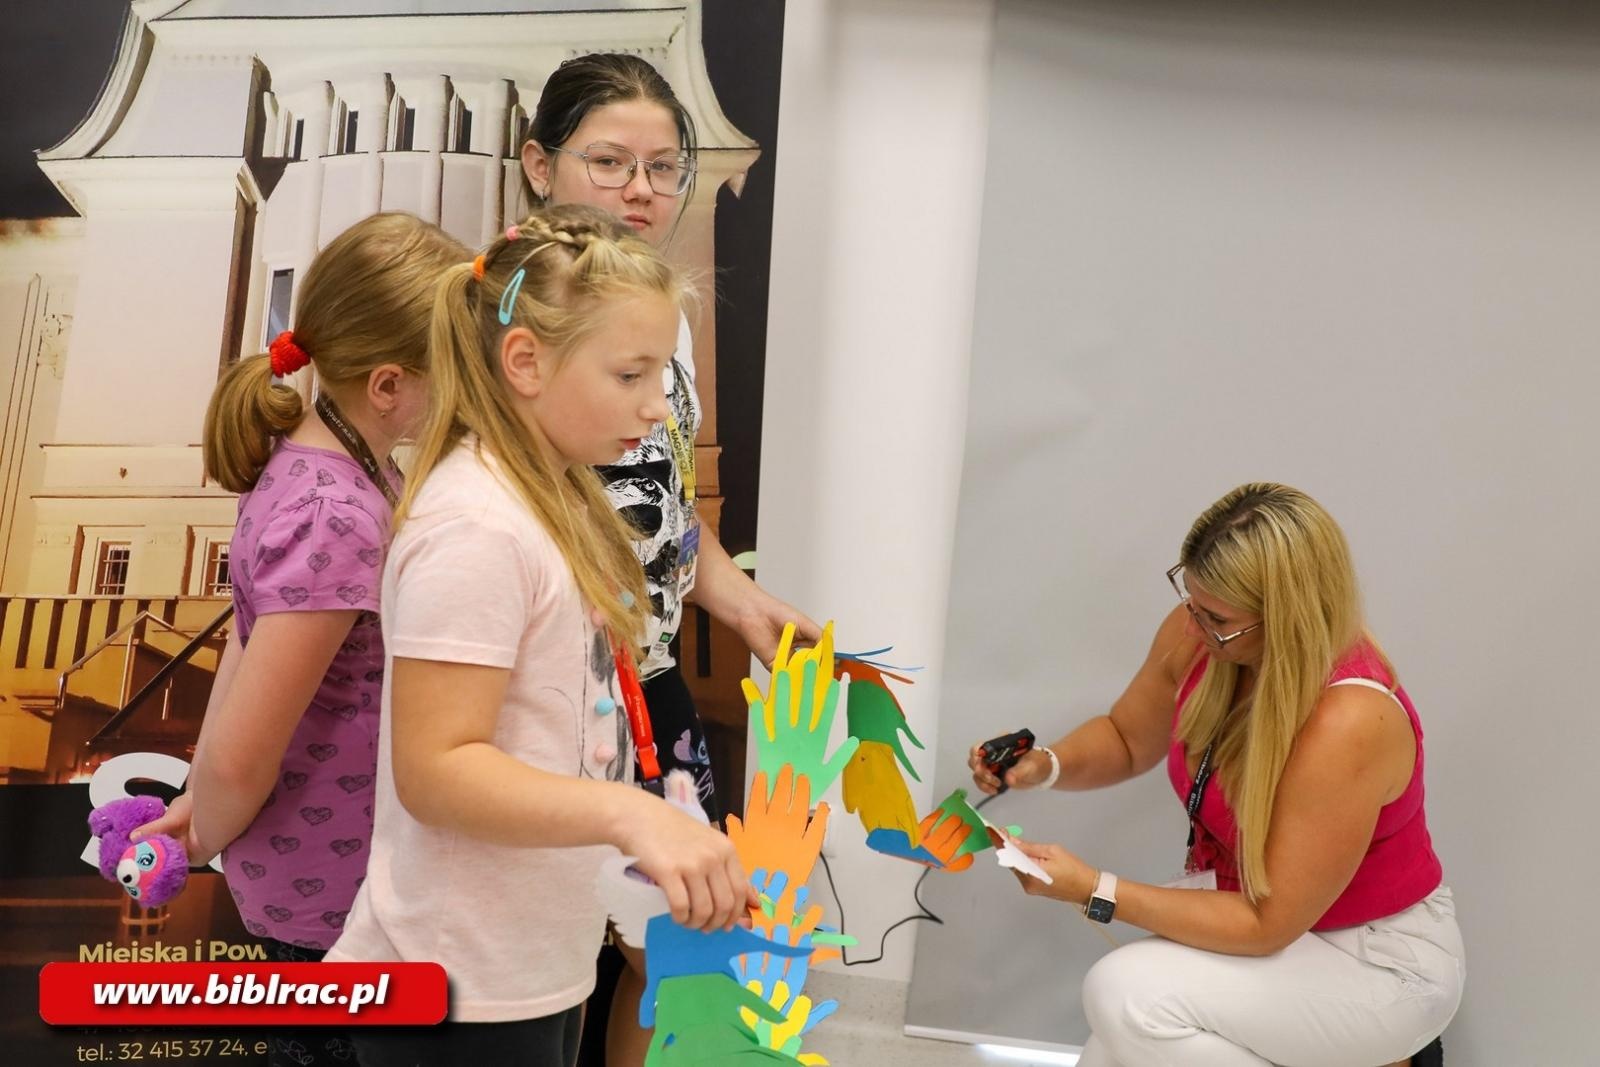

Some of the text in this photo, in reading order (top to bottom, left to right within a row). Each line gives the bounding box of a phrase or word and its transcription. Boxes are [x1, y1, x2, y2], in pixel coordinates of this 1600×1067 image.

[194, 939, 202, 962] i
[76, 1043, 113, 1062] tel.:
[117, 1042, 144, 1060] 32
[149, 1040, 183, 1059] 415
[188, 1039, 214, 1057] 37
[218, 1038, 249, 1056] 24,
